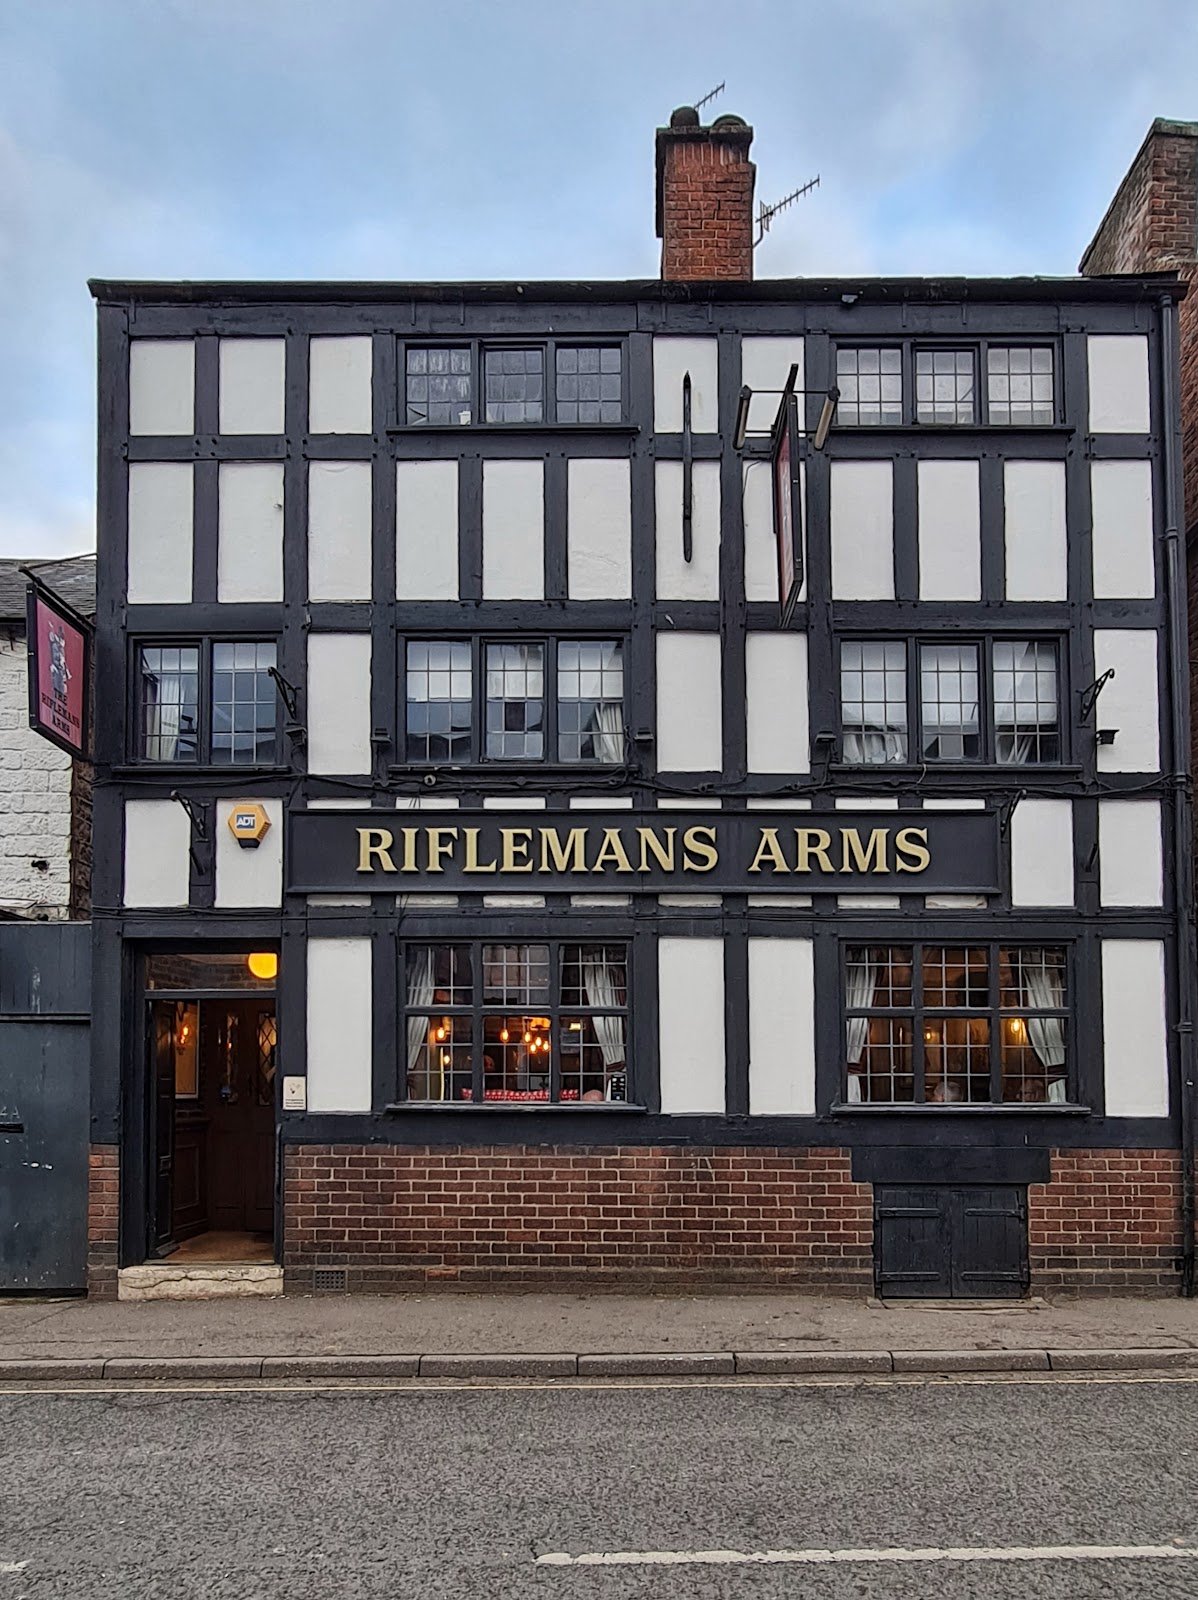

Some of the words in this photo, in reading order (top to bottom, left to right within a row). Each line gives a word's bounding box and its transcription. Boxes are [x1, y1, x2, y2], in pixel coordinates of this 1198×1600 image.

[54, 687, 68, 706] THE
[52, 714, 70, 736] ARMS
[237, 816, 255, 826] ADT
[356, 827, 719, 872] RIFLEMANS
[747, 827, 931, 872] ARMS
